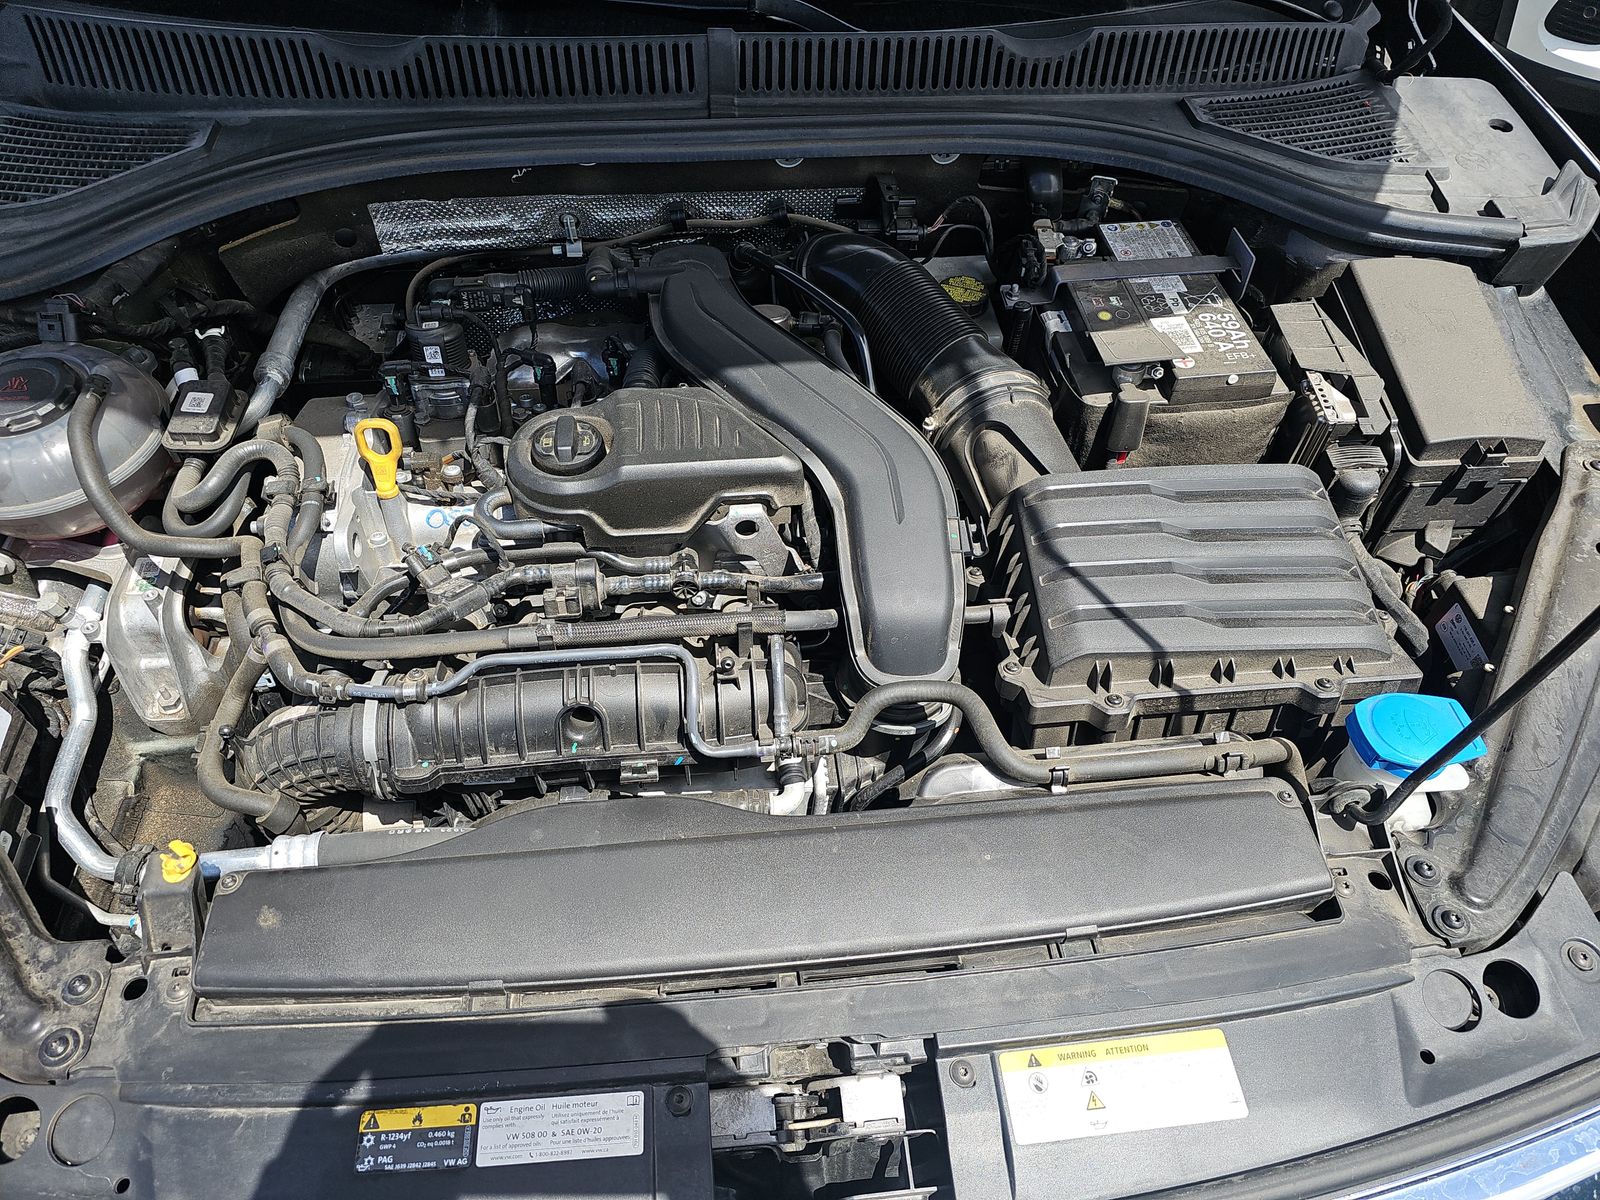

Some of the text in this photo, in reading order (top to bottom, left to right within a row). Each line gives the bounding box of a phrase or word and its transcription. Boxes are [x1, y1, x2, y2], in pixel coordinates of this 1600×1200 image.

[1168, 297, 1180, 307] Pb
[1198, 313, 1227, 338] 640
[1213, 341, 1235, 352] A
[1217, 313, 1251, 350] 59Ah
[1226, 351, 1256, 360] EFB+
[1057, 1044, 1149, 1061] WARNING ATTENTION
[509, 1104, 546, 1115] Engine Oil
[551, 1101, 598, 1110] Huile moteur
[380, 1131, 412, 1142] R-1234yf
[428, 1130, 456, 1139] 0.460 kg
[505, 1132, 520, 1141] VW
[521, 1131, 536, 1139] 508
[537, 1130, 548, 1138] 00
[577, 1126, 603, 1135] 0W-20
[434, 1139, 451, 1147] 0.0018
[377, 1155, 394, 1164] PAG
[443, 1157, 468, 1167] VW AG
